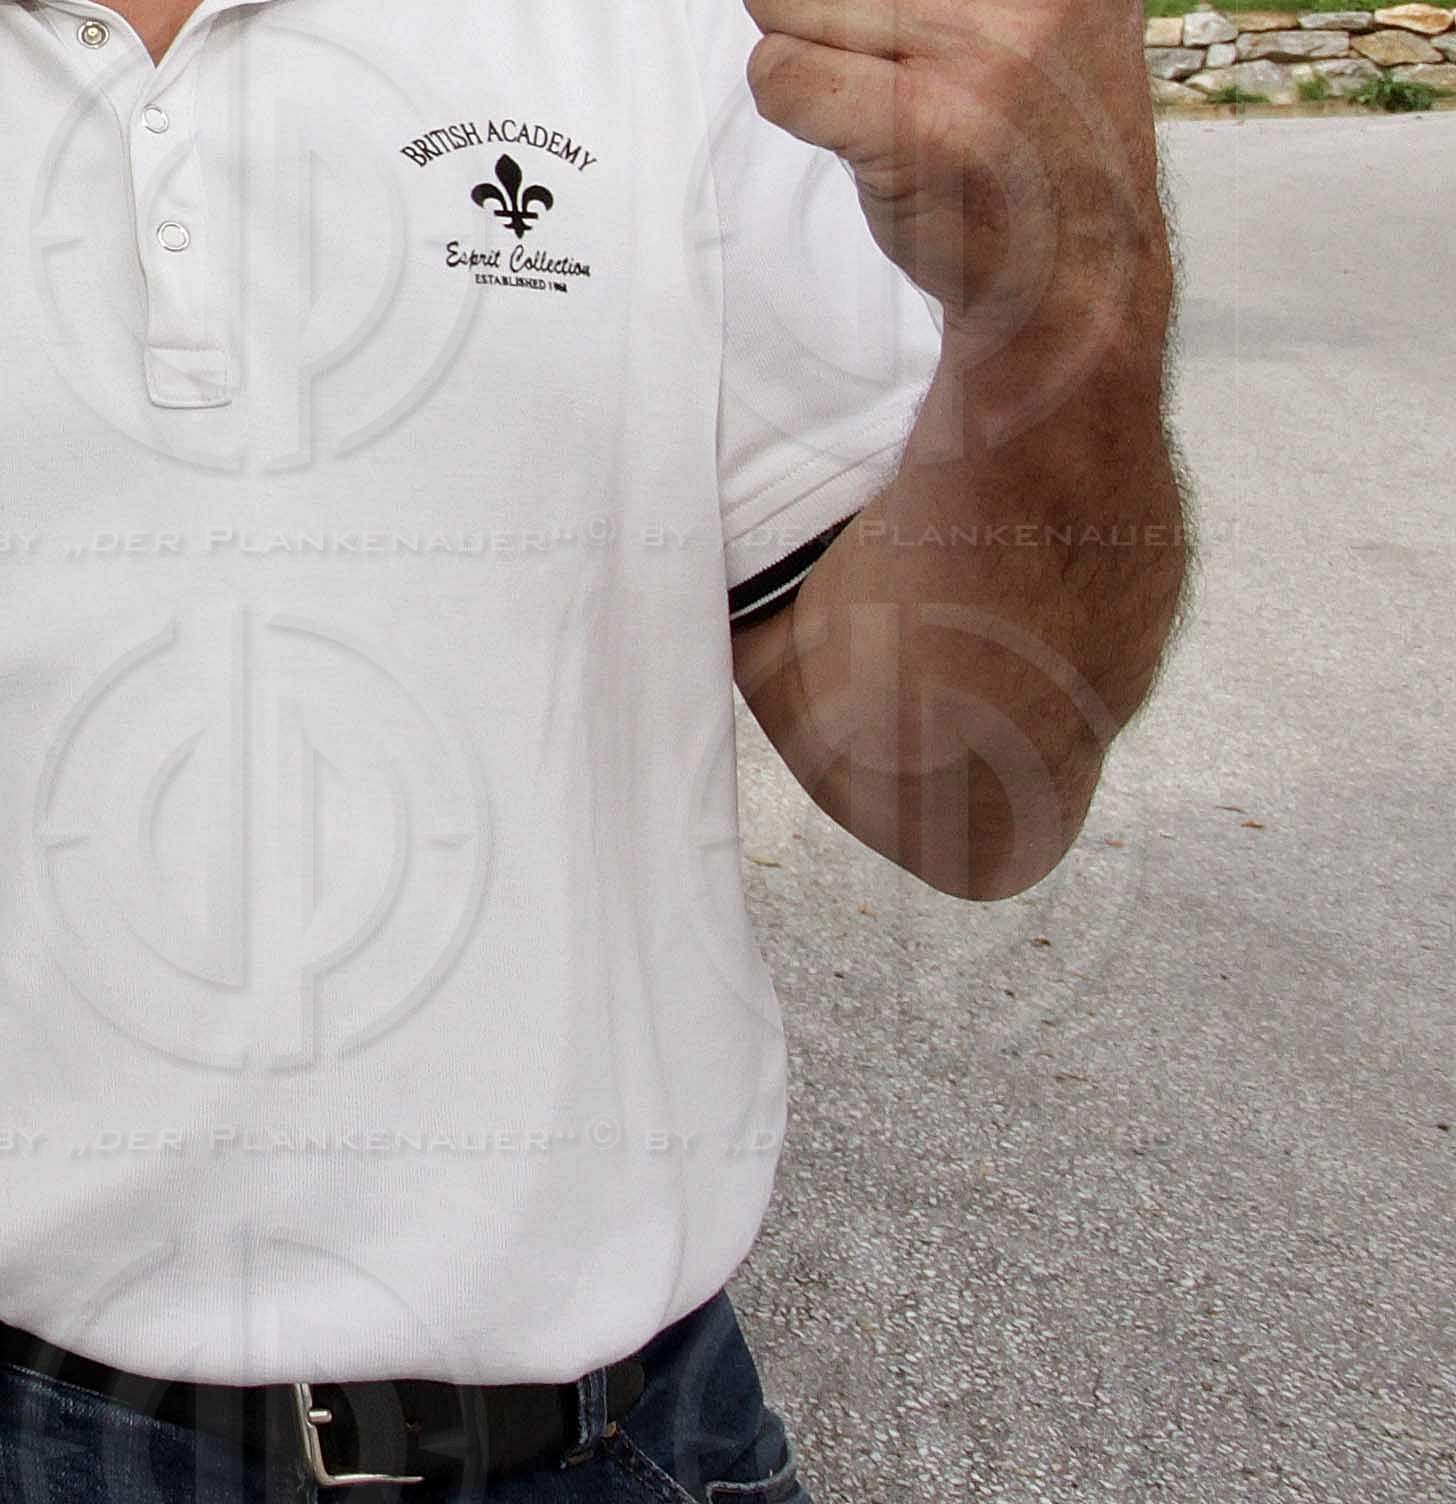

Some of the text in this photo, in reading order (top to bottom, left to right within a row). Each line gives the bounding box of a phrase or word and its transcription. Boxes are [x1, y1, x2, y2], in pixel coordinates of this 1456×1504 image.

[400, 119, 598, 172] BRITISH ACADEMY
[445, 240, 591, 278] Esprit Collection
